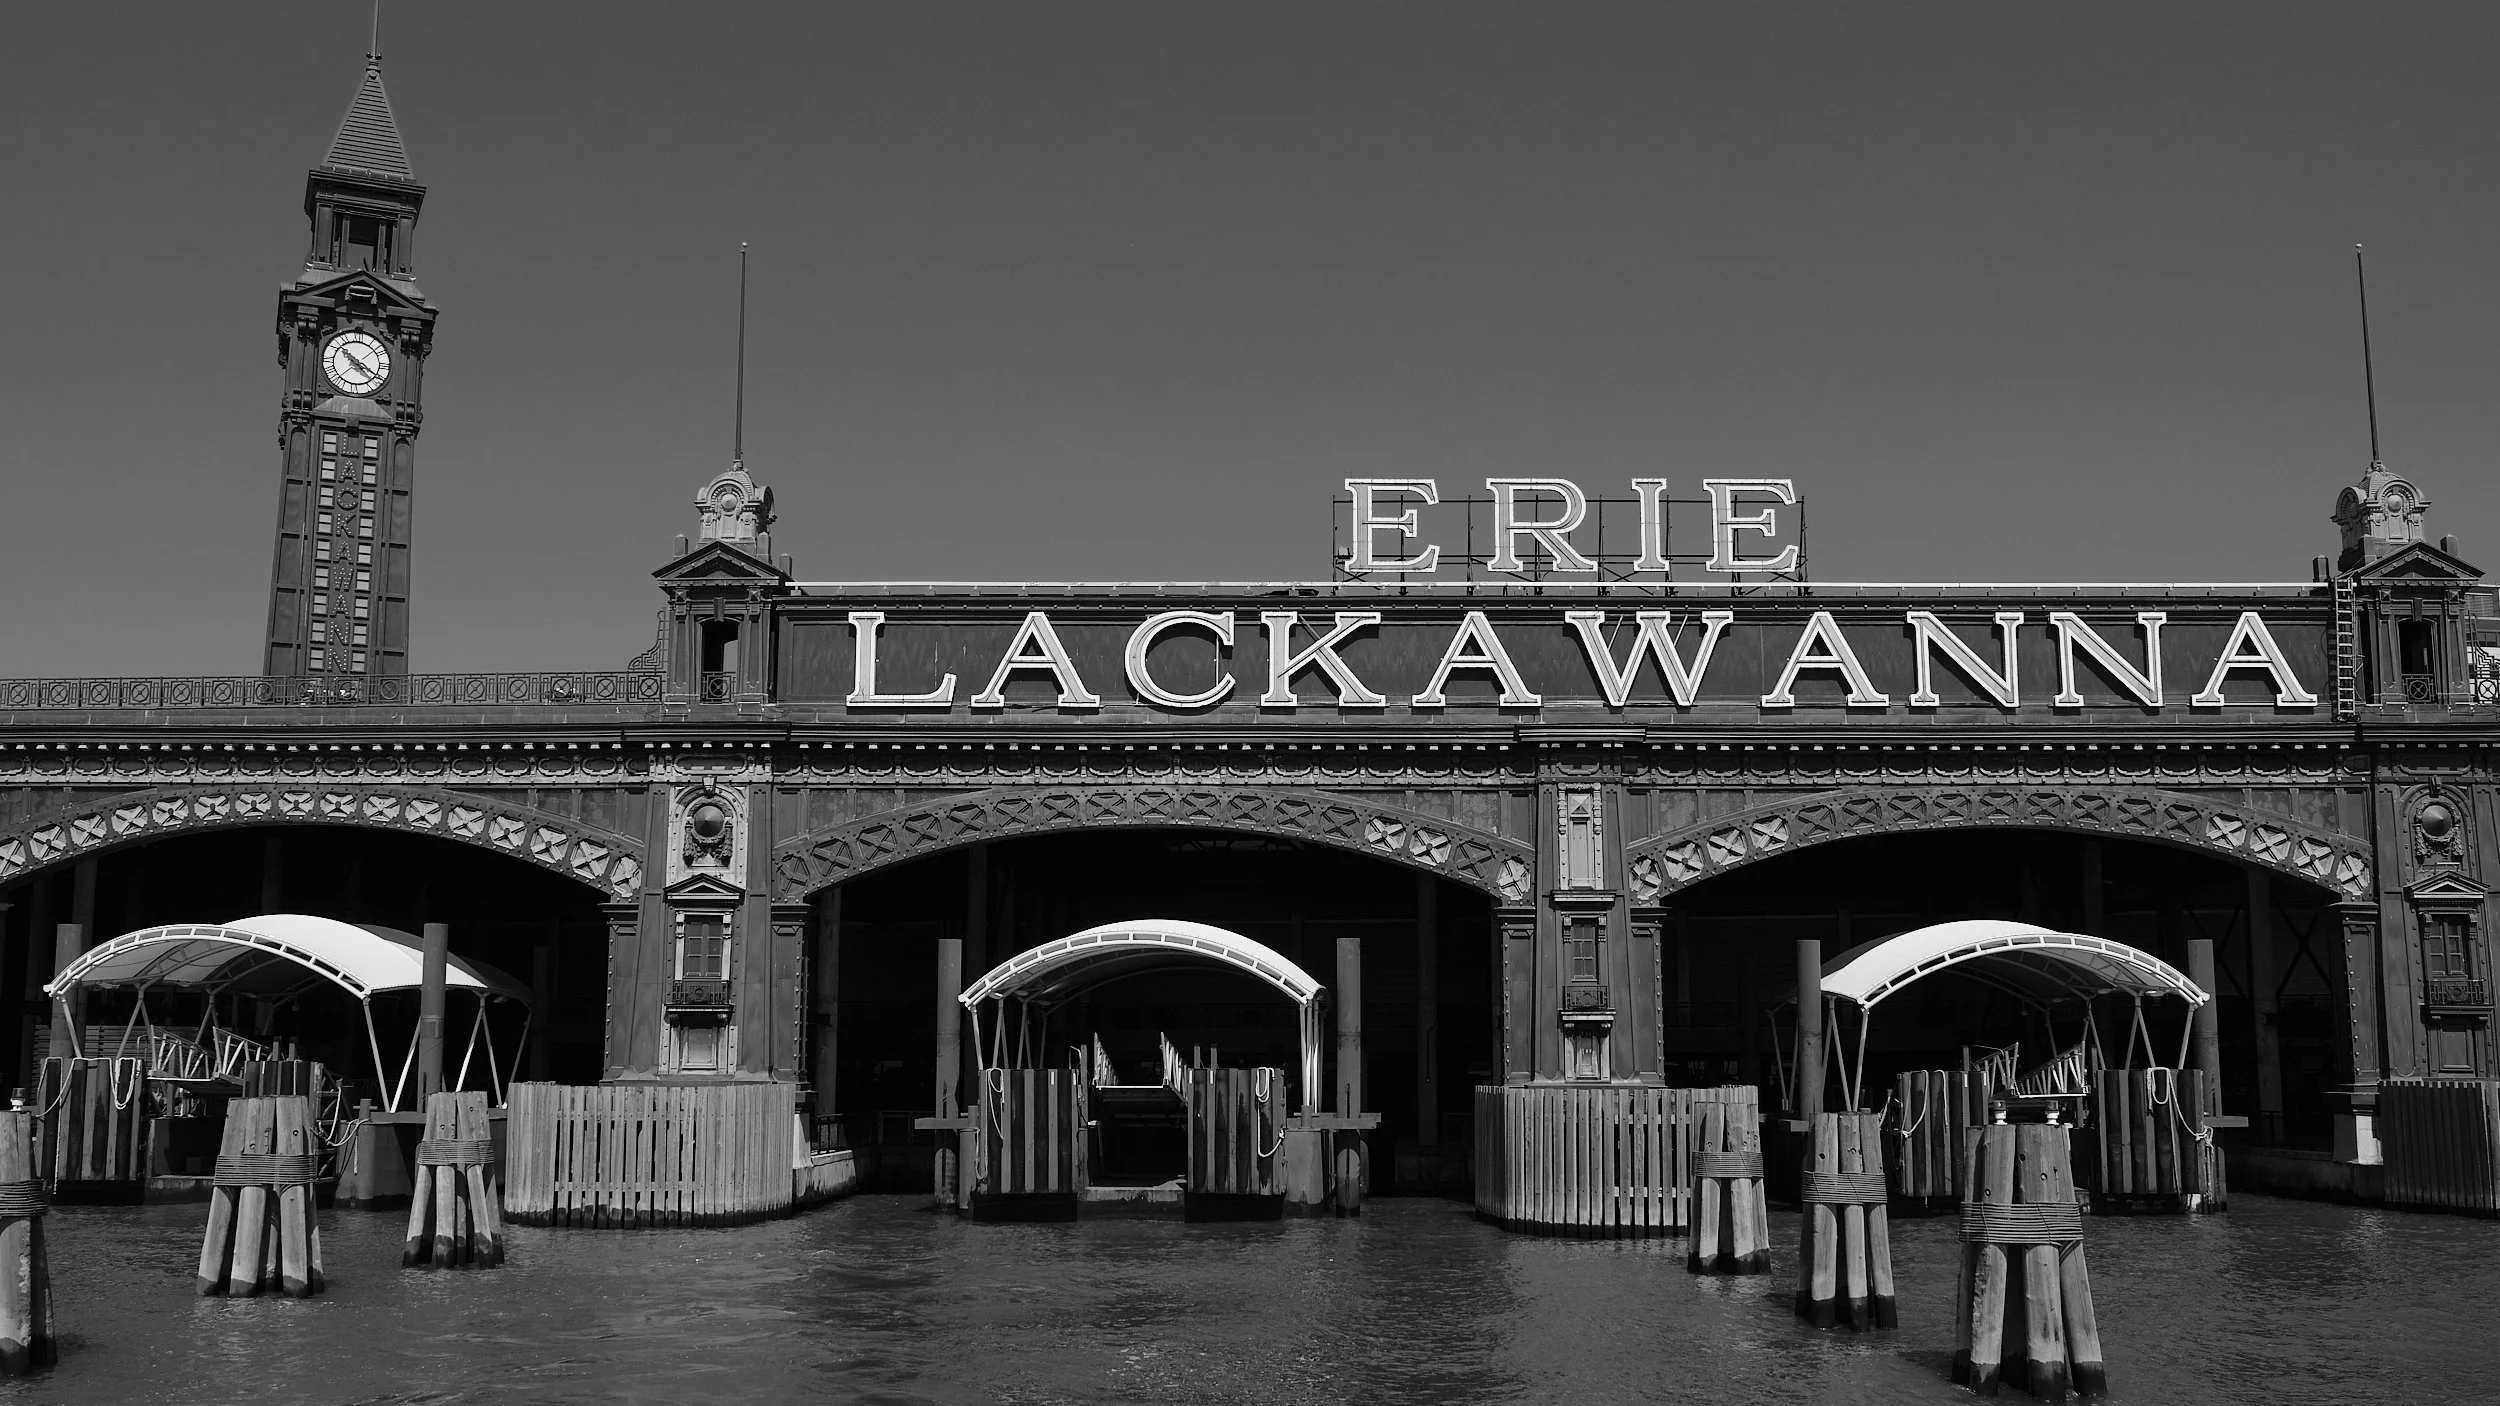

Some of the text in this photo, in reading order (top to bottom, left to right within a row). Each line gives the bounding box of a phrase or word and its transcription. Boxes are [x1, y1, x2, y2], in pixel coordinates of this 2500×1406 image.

[328, 433, 359, 681] LACKAWANN
[1345, 478, 1799, 573] ERIE
[846, 611, 2317, 707] LACKAWANNA
